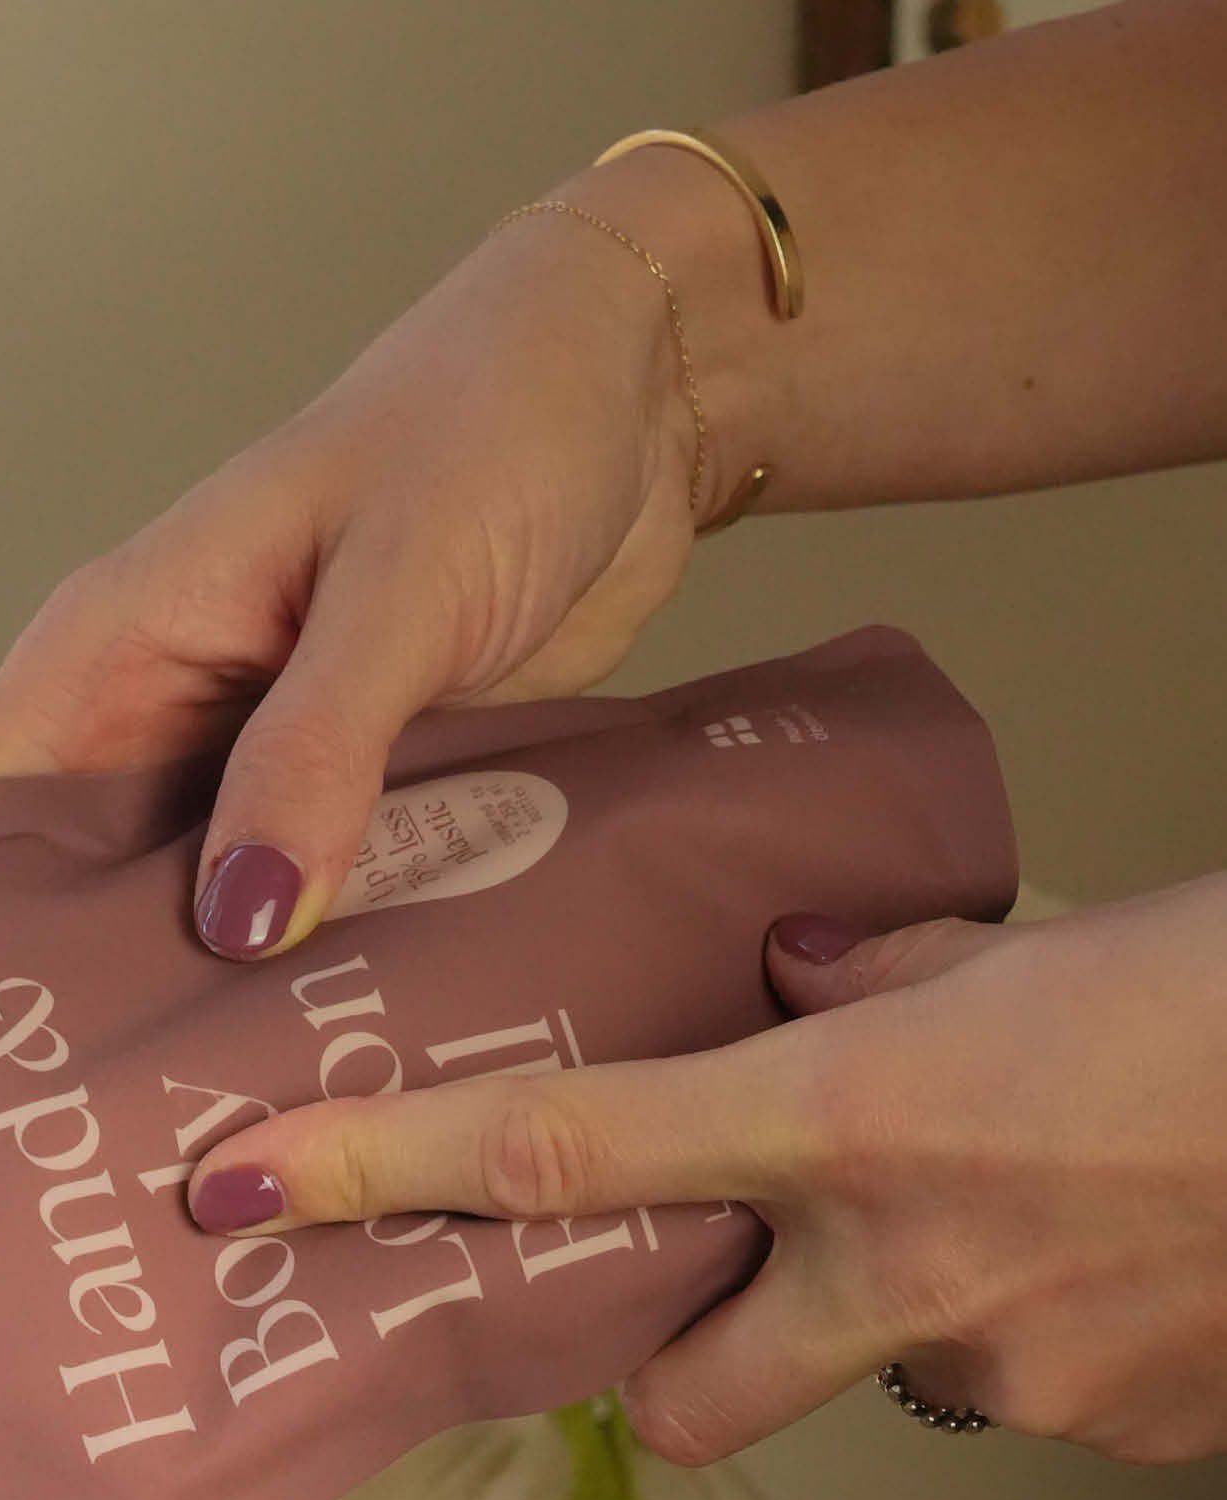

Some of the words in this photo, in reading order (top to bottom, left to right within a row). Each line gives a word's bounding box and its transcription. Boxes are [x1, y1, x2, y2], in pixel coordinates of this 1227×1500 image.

[380, 804, 422, 857] less
[424, 800, 490, 865] plastic
[290, 953, 484, 1340] Lon
